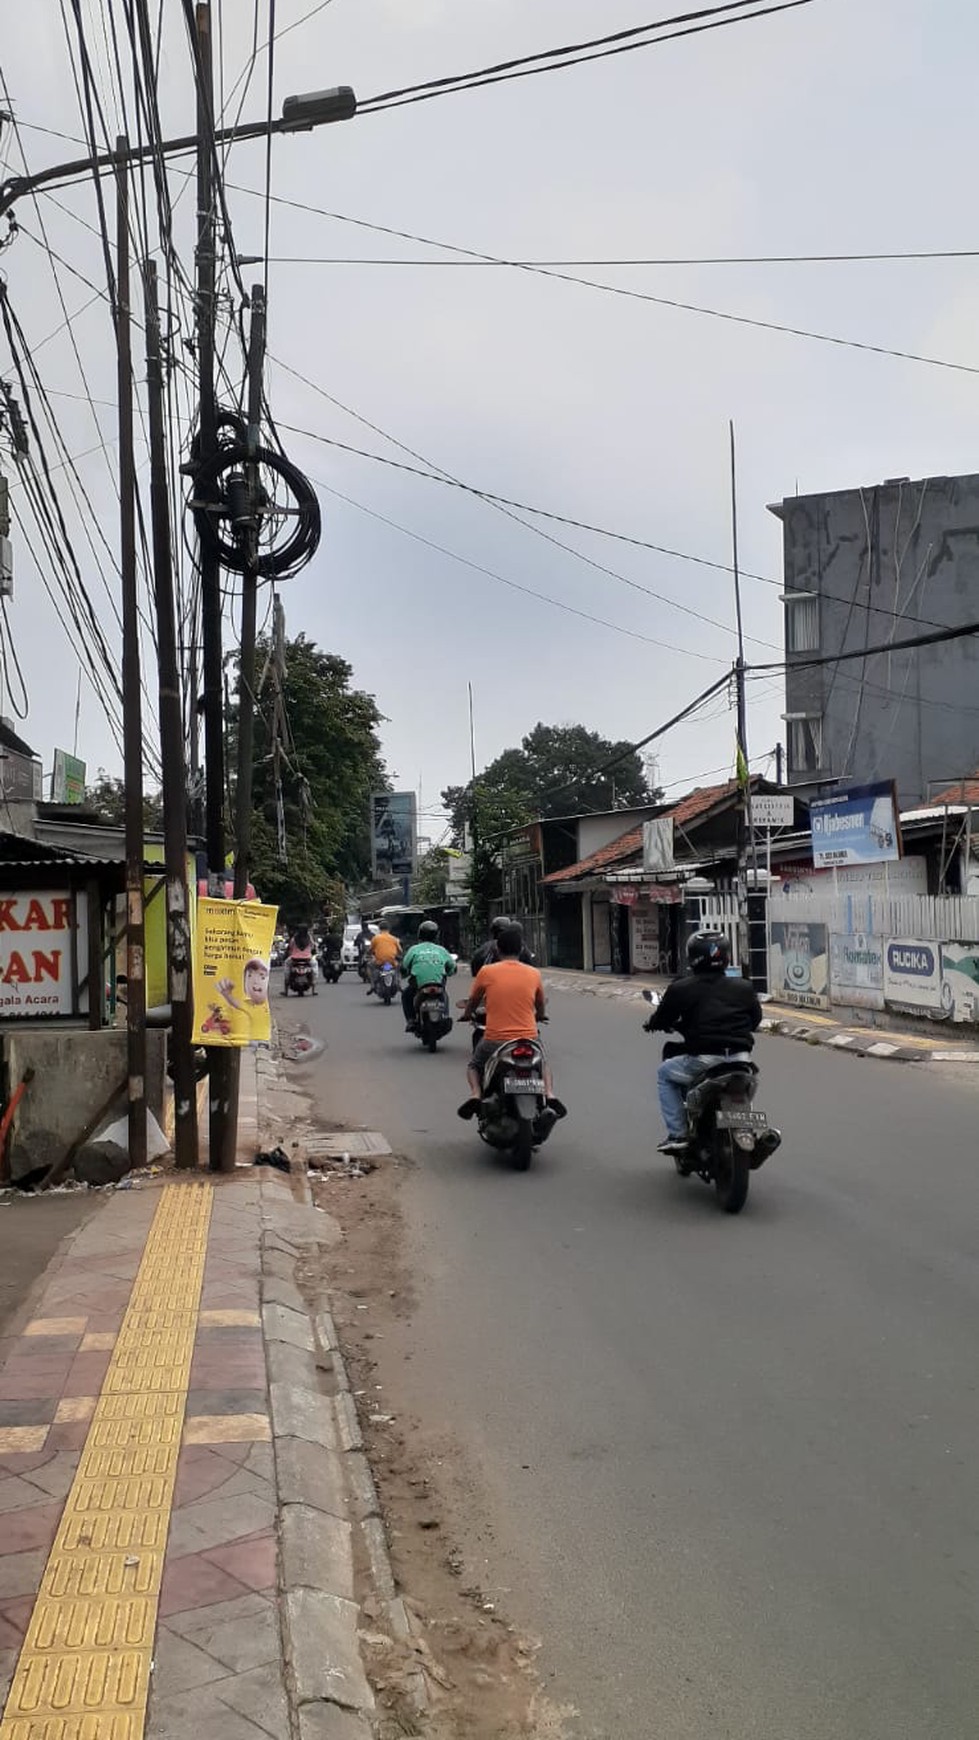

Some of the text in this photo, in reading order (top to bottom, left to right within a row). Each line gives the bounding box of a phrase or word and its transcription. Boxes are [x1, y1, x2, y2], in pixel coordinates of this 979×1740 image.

[0, 950, 61, 983] AN
[893, 950, 928, 970] RUCIKA
[25, 995, 59, 1005] Acara
